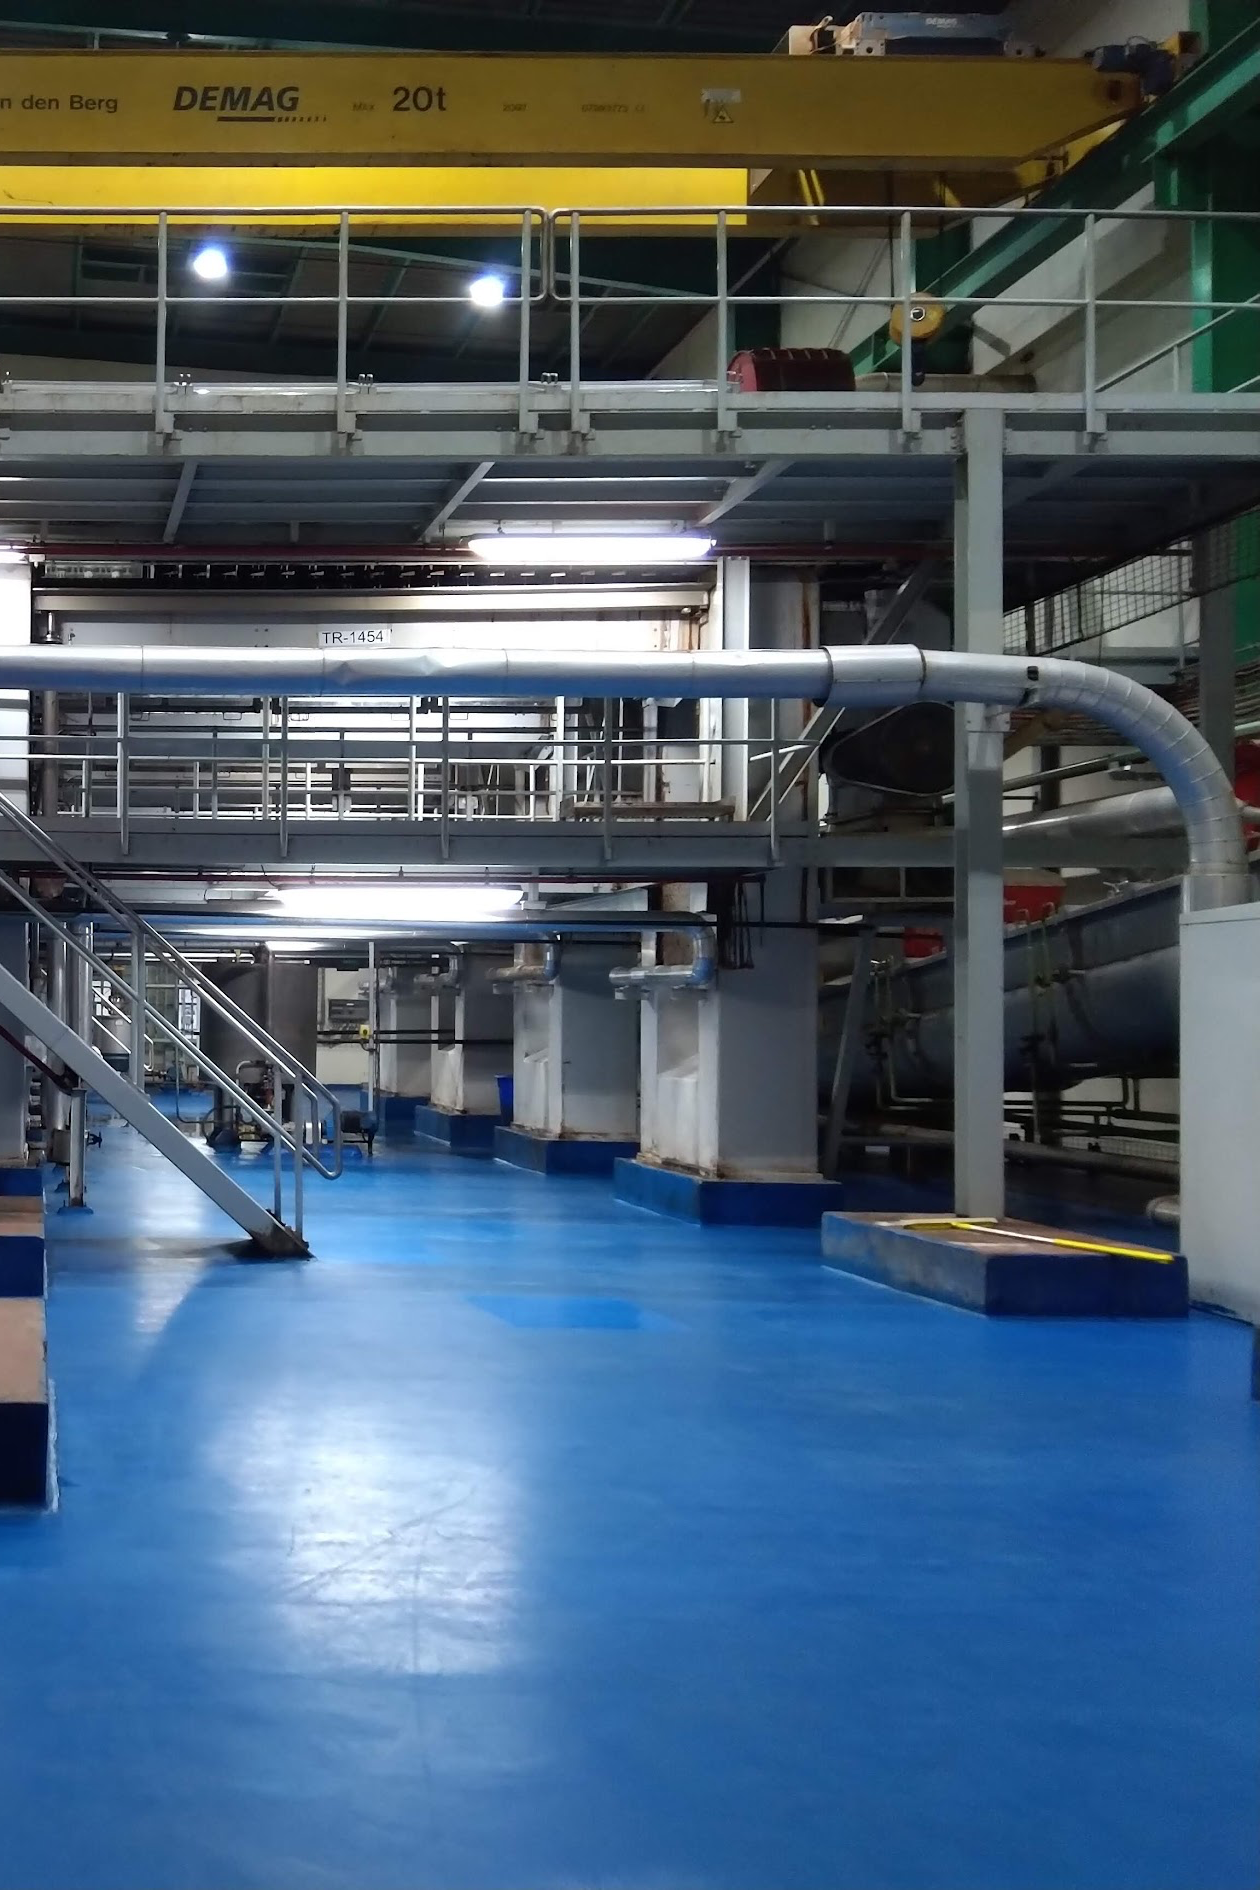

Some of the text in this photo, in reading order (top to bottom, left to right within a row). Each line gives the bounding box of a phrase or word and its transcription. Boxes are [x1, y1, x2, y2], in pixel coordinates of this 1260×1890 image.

[21, 95, 59, 110] den
[69, 95, 118, 114] Berg
[173, 86, 299, 112] DEMAG
[393, 86, 447, 112] 20t
[322, 630, 384, 644] TR-1454
